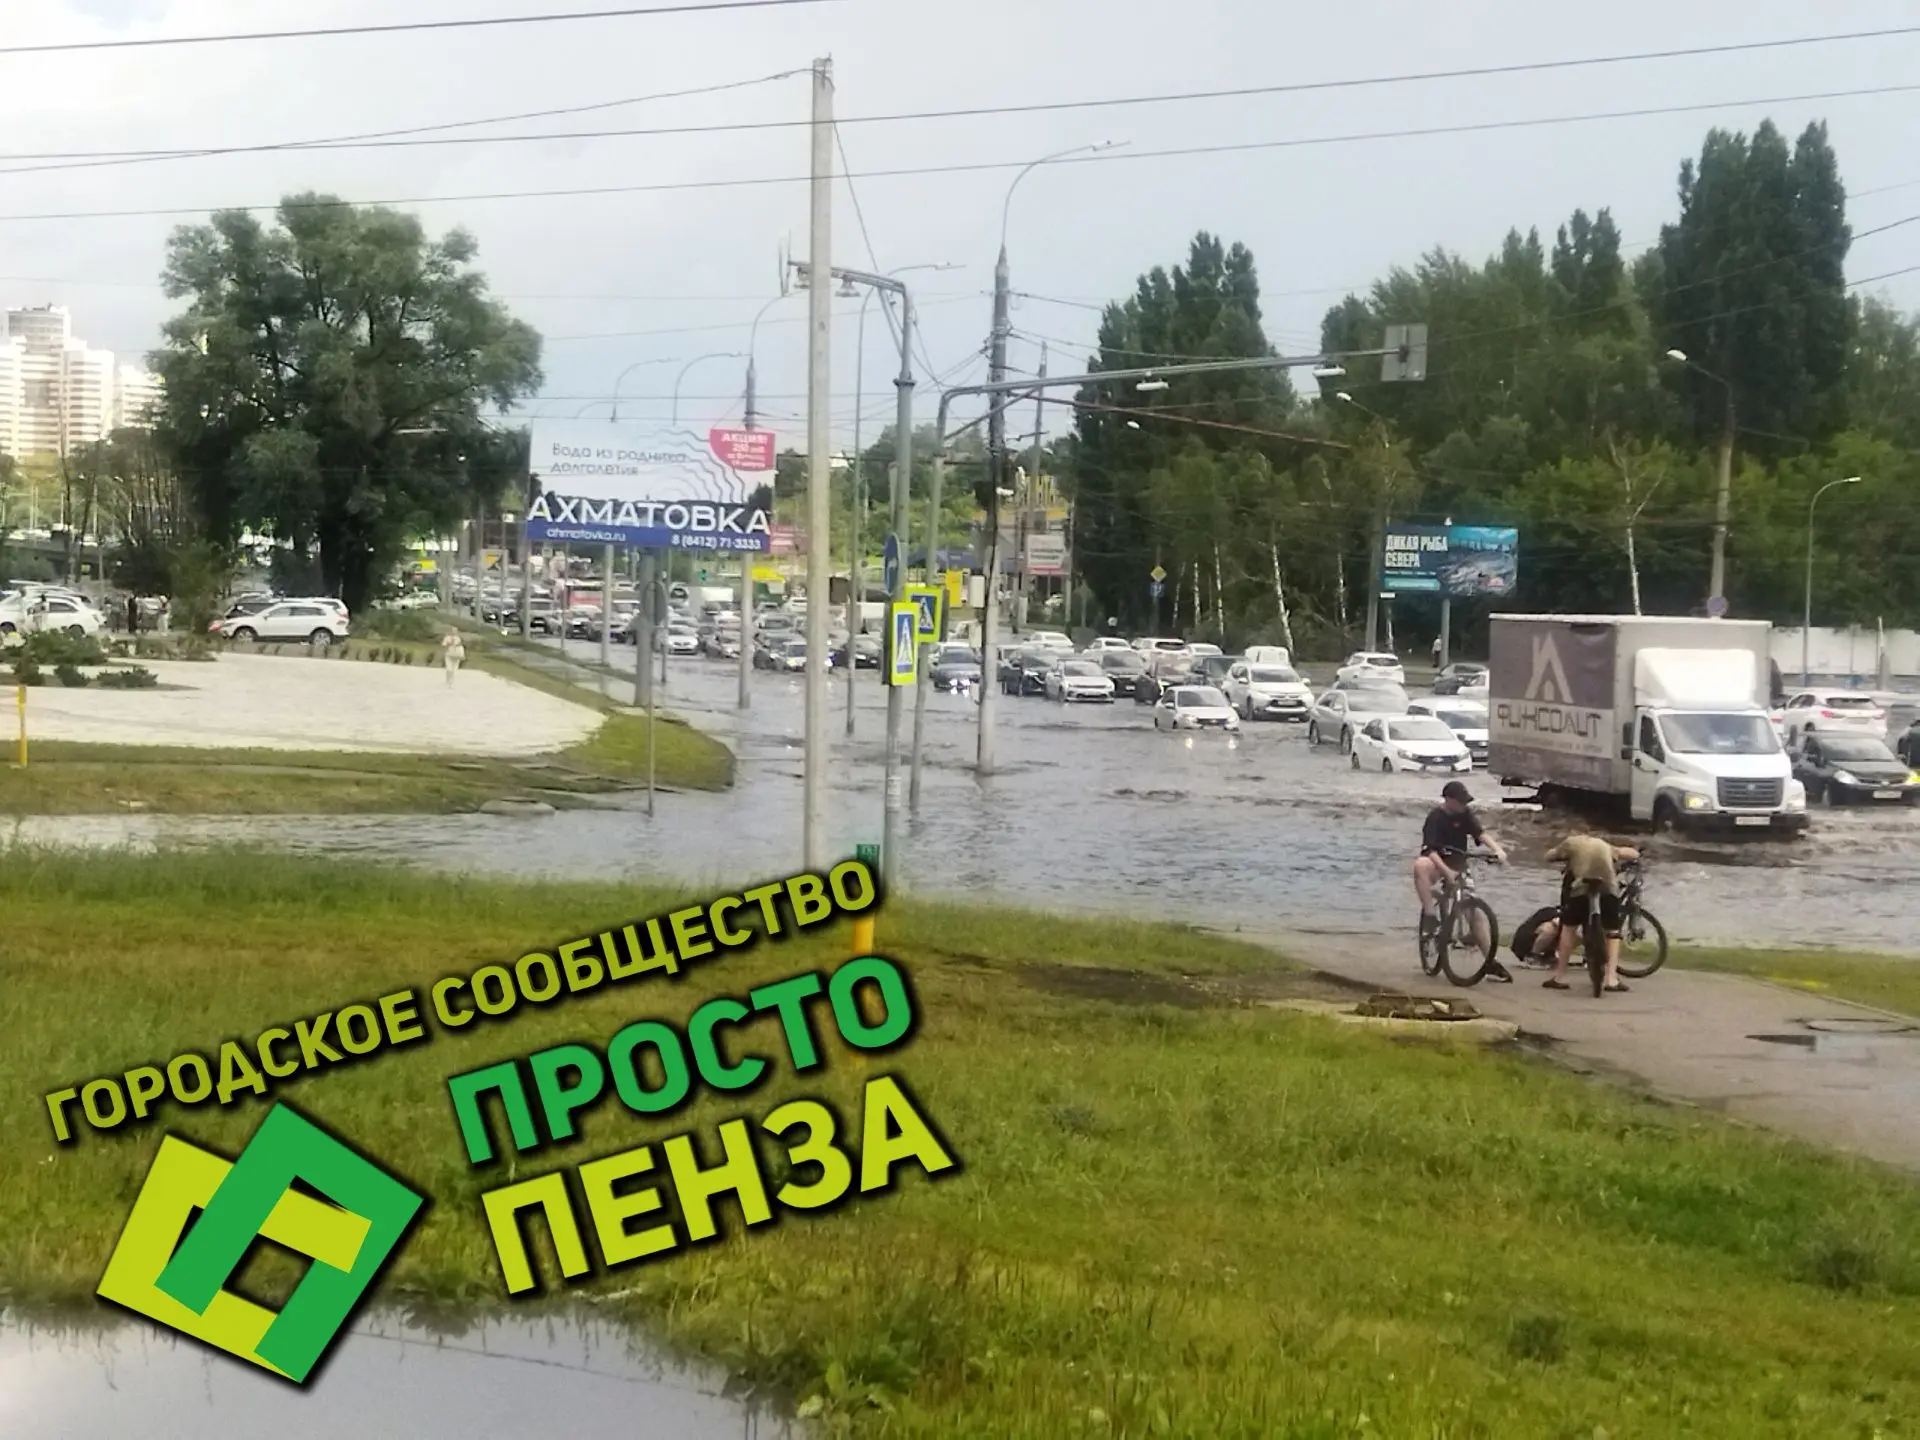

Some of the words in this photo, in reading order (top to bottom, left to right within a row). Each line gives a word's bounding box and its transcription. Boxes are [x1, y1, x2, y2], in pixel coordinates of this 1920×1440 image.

[552, 442, 591, 458] Вода
[596, 449, 613, 459] из
[617, 450, 688, 464] родника
[527, 496, 771, 535] АХМАТОВКА
[546, 527, 626, 542] ahmatovka.ru
[671, 534, 680, 546] 8
[682, 534, 717, 549] (8412)
[1420, 536, 1448, 551] РЫБА
